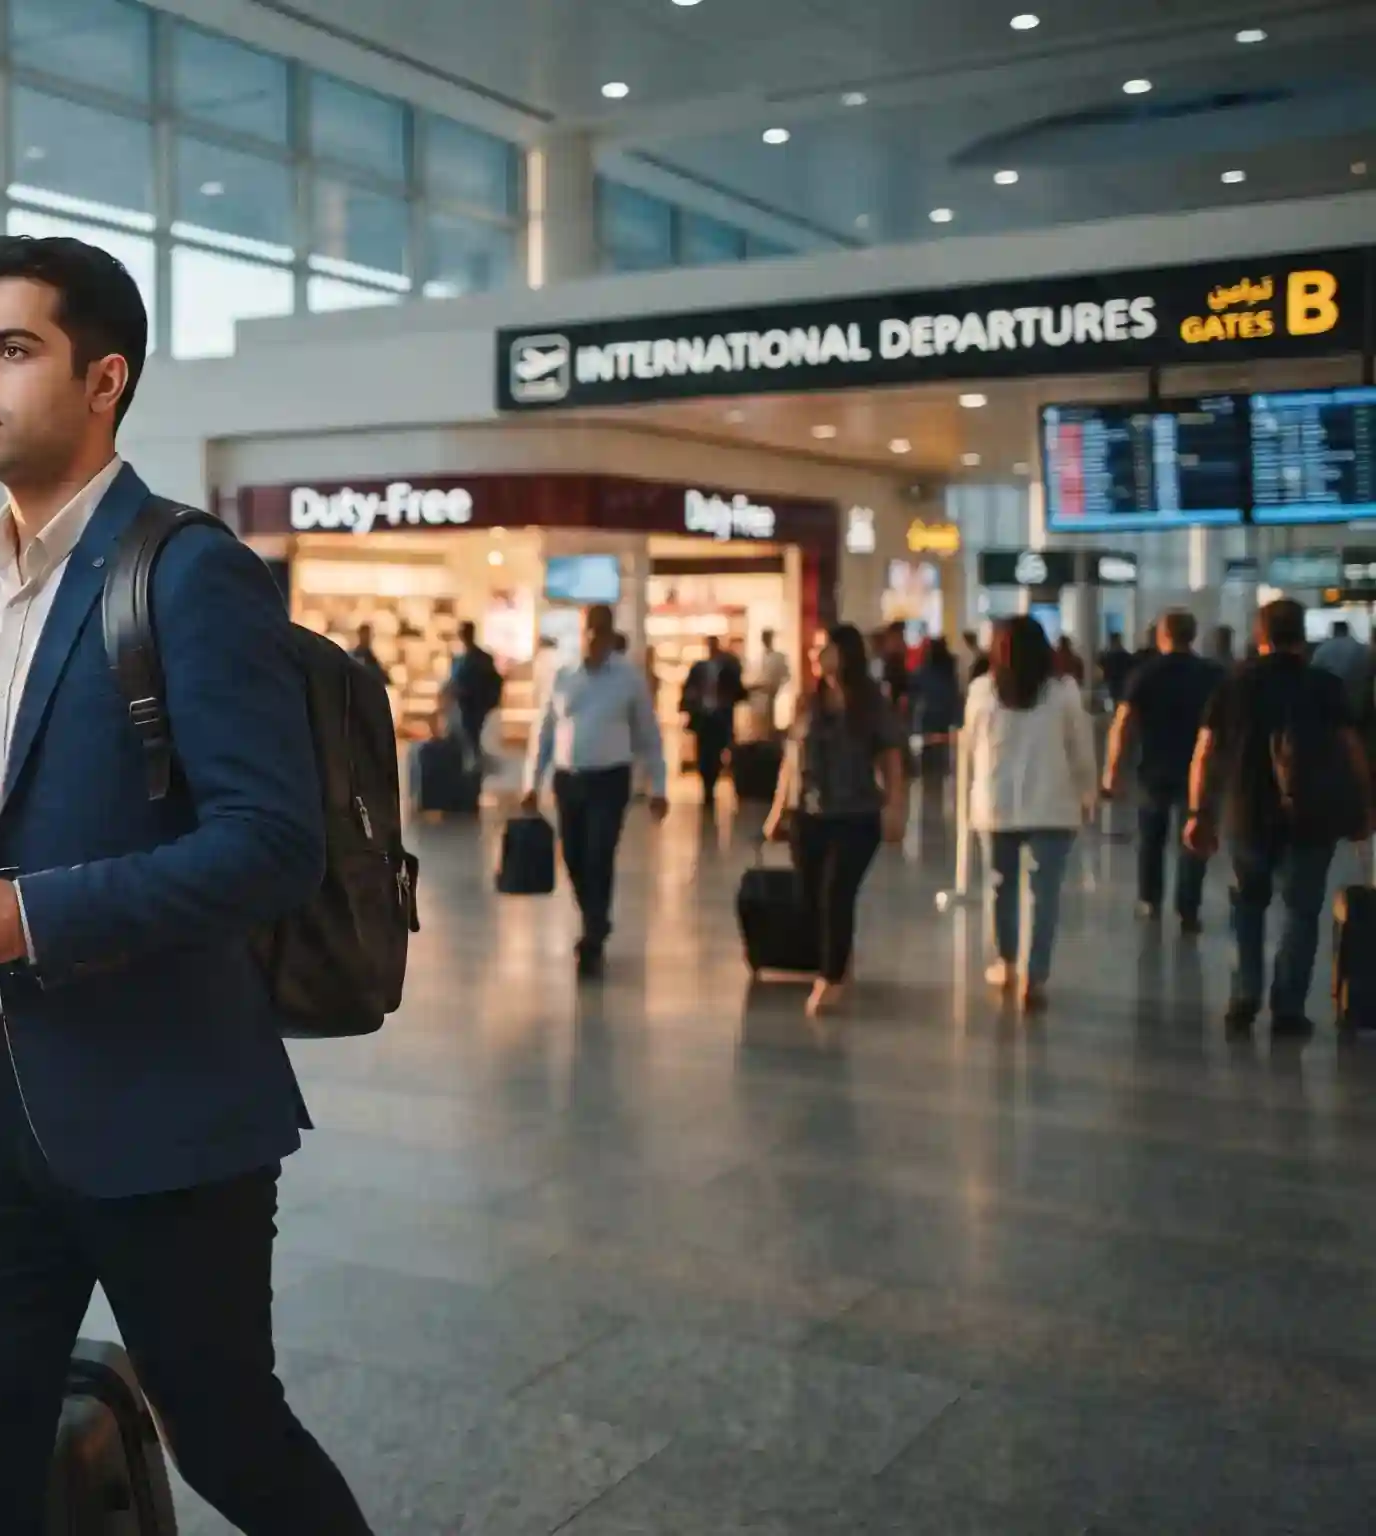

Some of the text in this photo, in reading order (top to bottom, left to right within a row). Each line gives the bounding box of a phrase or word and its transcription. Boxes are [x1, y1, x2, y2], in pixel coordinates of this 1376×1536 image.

[1180, 310, 1273, 344] GATES
[1286, 269, 1339, 336] B
[576, 296, 1157, 383] INTERNATIONAL DEPARTURES
[290, 482, 473, 536] Duty-Free
